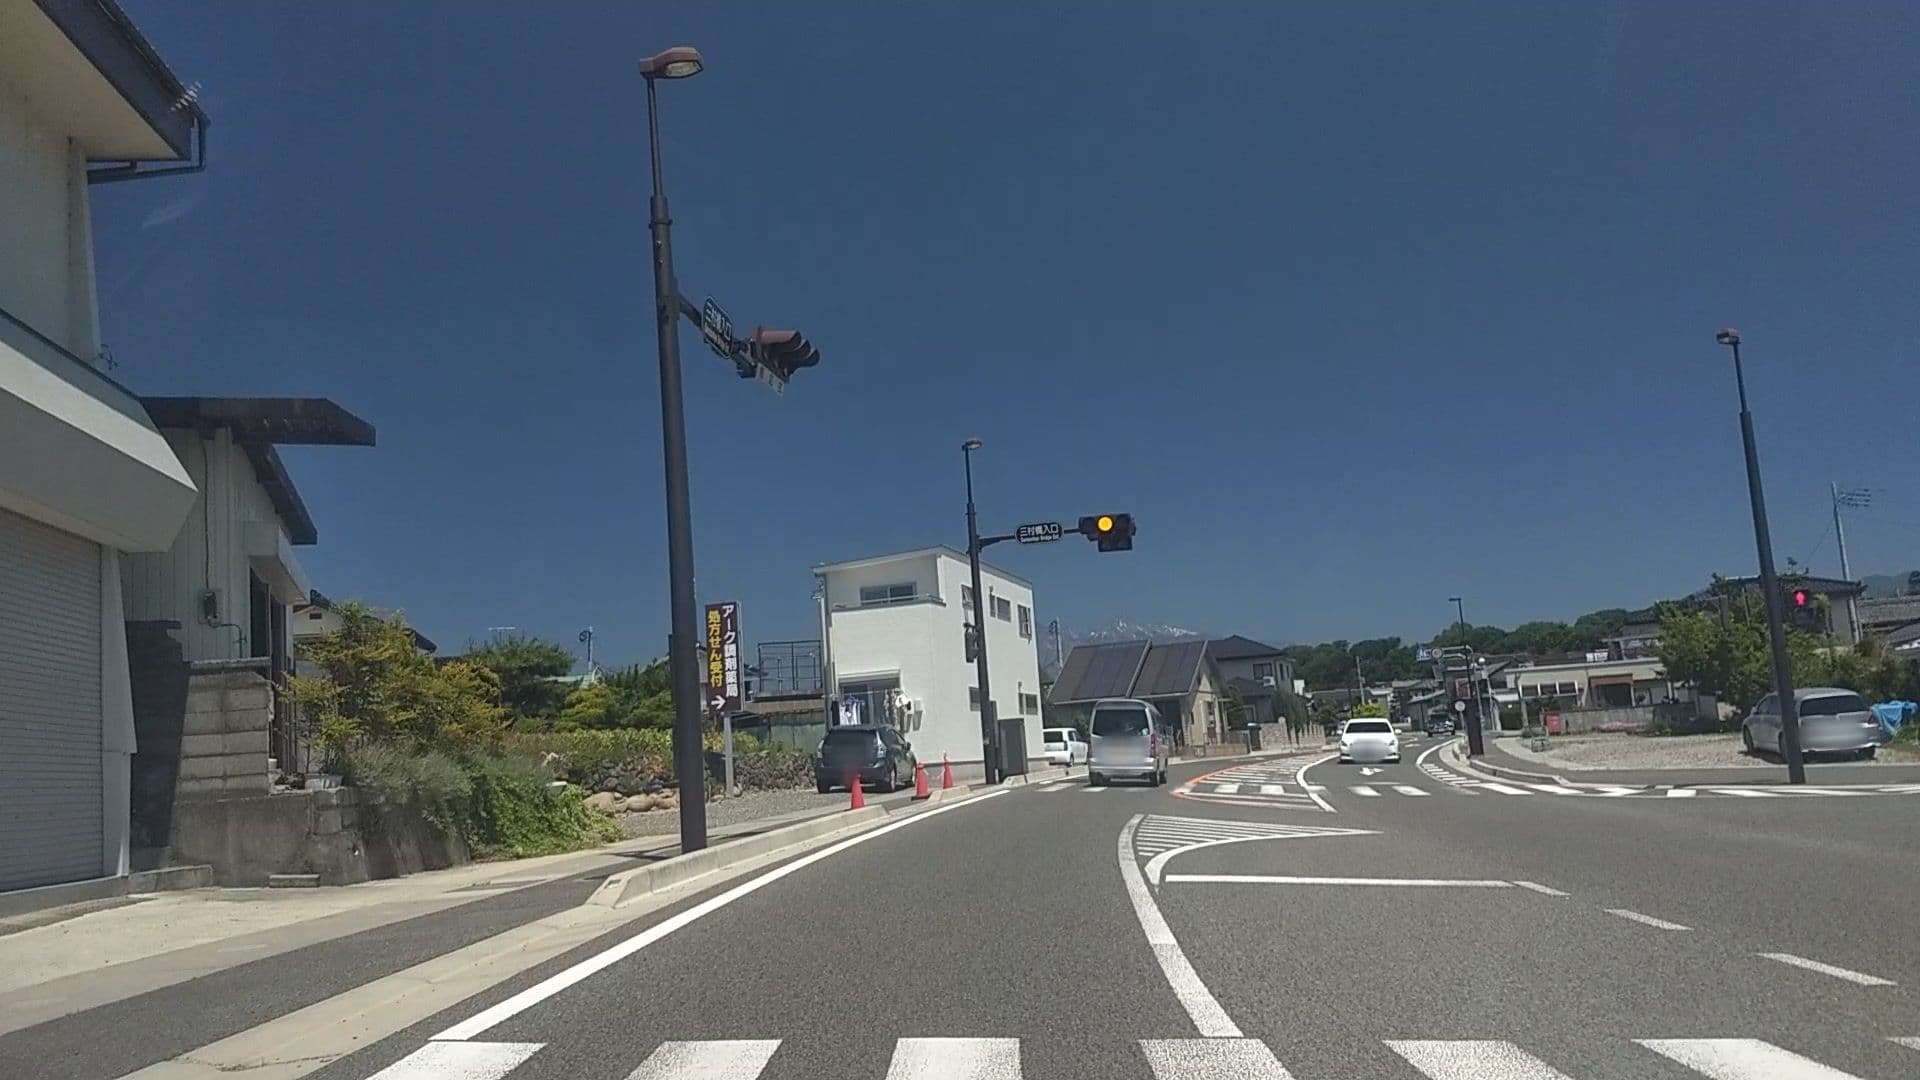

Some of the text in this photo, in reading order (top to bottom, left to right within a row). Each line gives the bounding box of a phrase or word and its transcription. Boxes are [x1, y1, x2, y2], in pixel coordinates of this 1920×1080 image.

[708, 610, 723, 688] 処方せん受付
[722, 604, 738, 697] アーク調剤薬局
